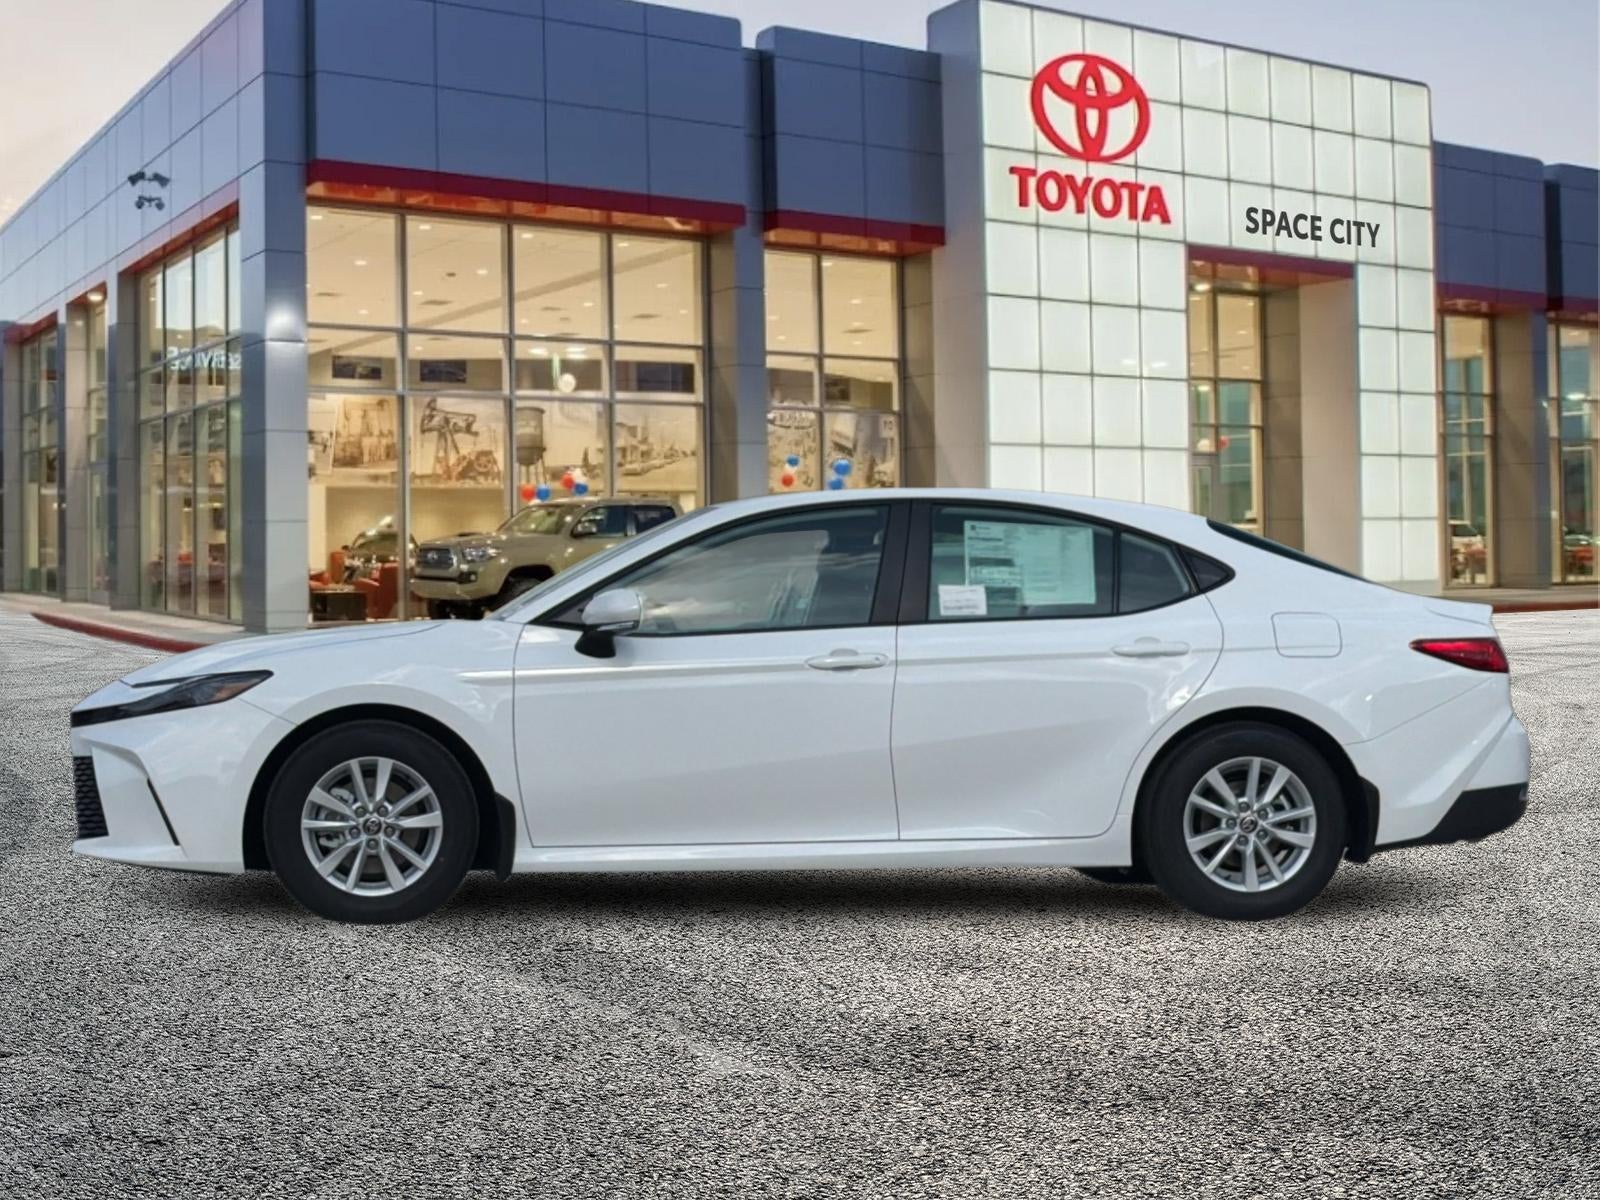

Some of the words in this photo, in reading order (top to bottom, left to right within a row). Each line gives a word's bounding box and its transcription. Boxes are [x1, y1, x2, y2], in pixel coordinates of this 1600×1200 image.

[1009, 165, 1171, 225] TOYOTA
[1245, 206, 1323, 242] SPACE
[1329, 218, 1381, 248] CITY
